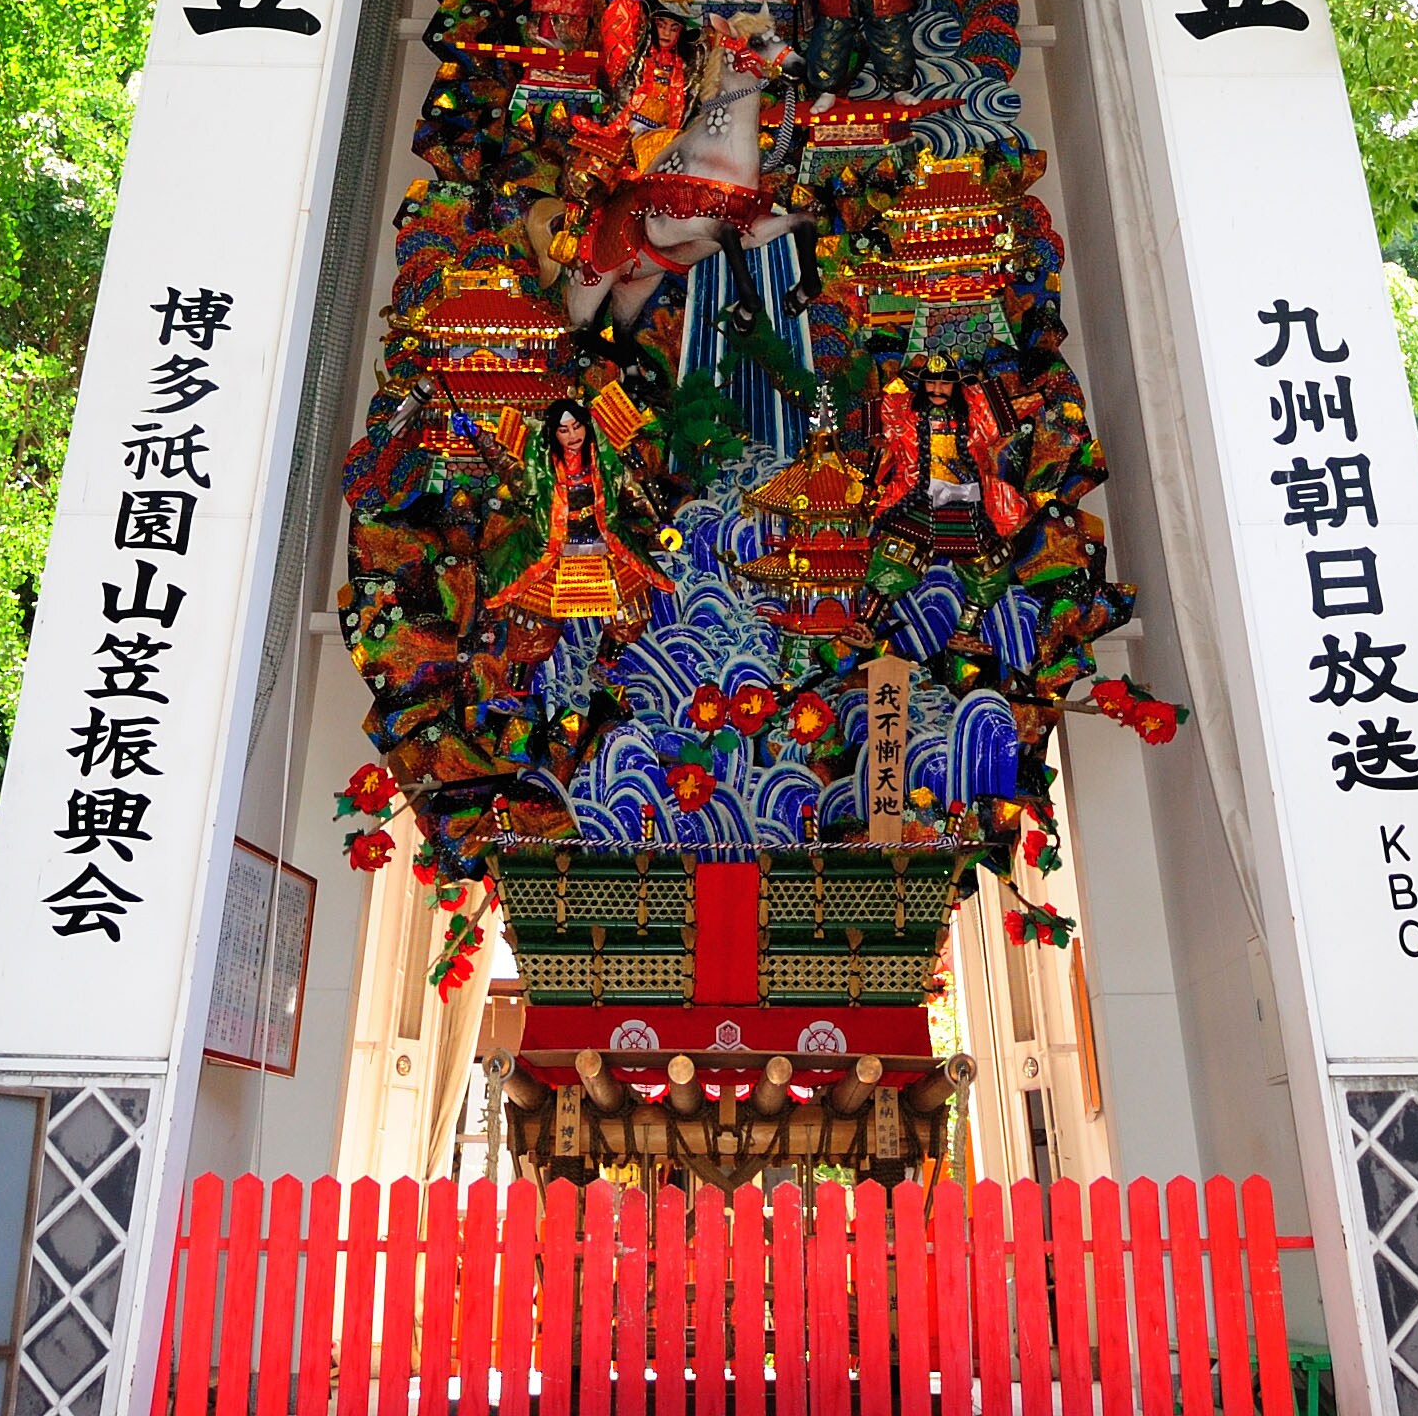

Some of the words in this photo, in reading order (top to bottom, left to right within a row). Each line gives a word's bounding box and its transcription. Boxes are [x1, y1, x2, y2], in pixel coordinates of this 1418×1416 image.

[41, 286, 235, 943] 博多祇園山笠振興会
